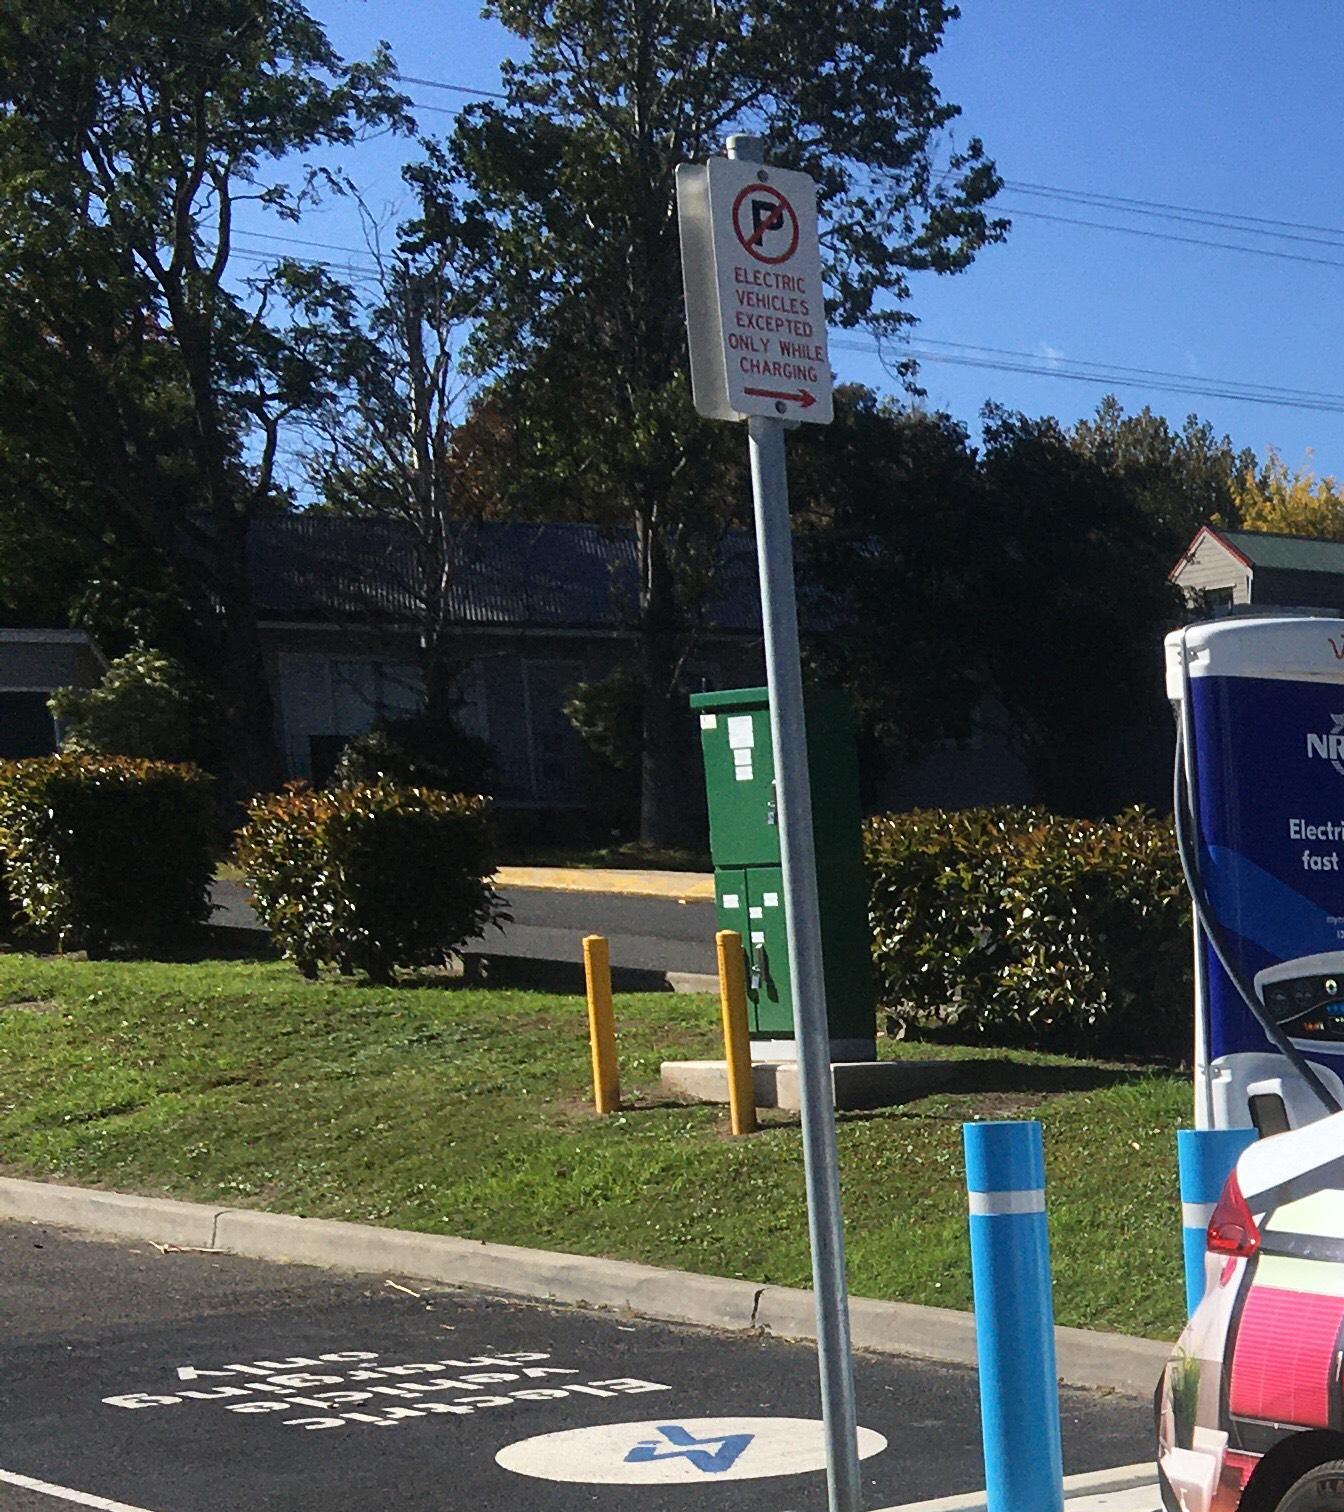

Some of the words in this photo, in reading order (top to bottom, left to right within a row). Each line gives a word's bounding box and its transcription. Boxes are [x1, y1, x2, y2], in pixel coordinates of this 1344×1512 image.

[751, 199, 785, 247] P
[735, 266, 806, 294] ELECTRIC
[736, 289, 809, 316] VEHICLES
[736, 311, 813, 338] EXCEPTED
[728, 332, 770, 352] ONLY
[779, 339, 825, 364] WHILE
[740, 356, 818, 383] CHARGING
[1302, 849, 1339, 871] fast
[101, 1352, 551, 1410] charging
[175, 1351, 380, 1381] only
[224, 1366, 580, 1413] vehicle
[283, 1377, 673, 1430] Electric
